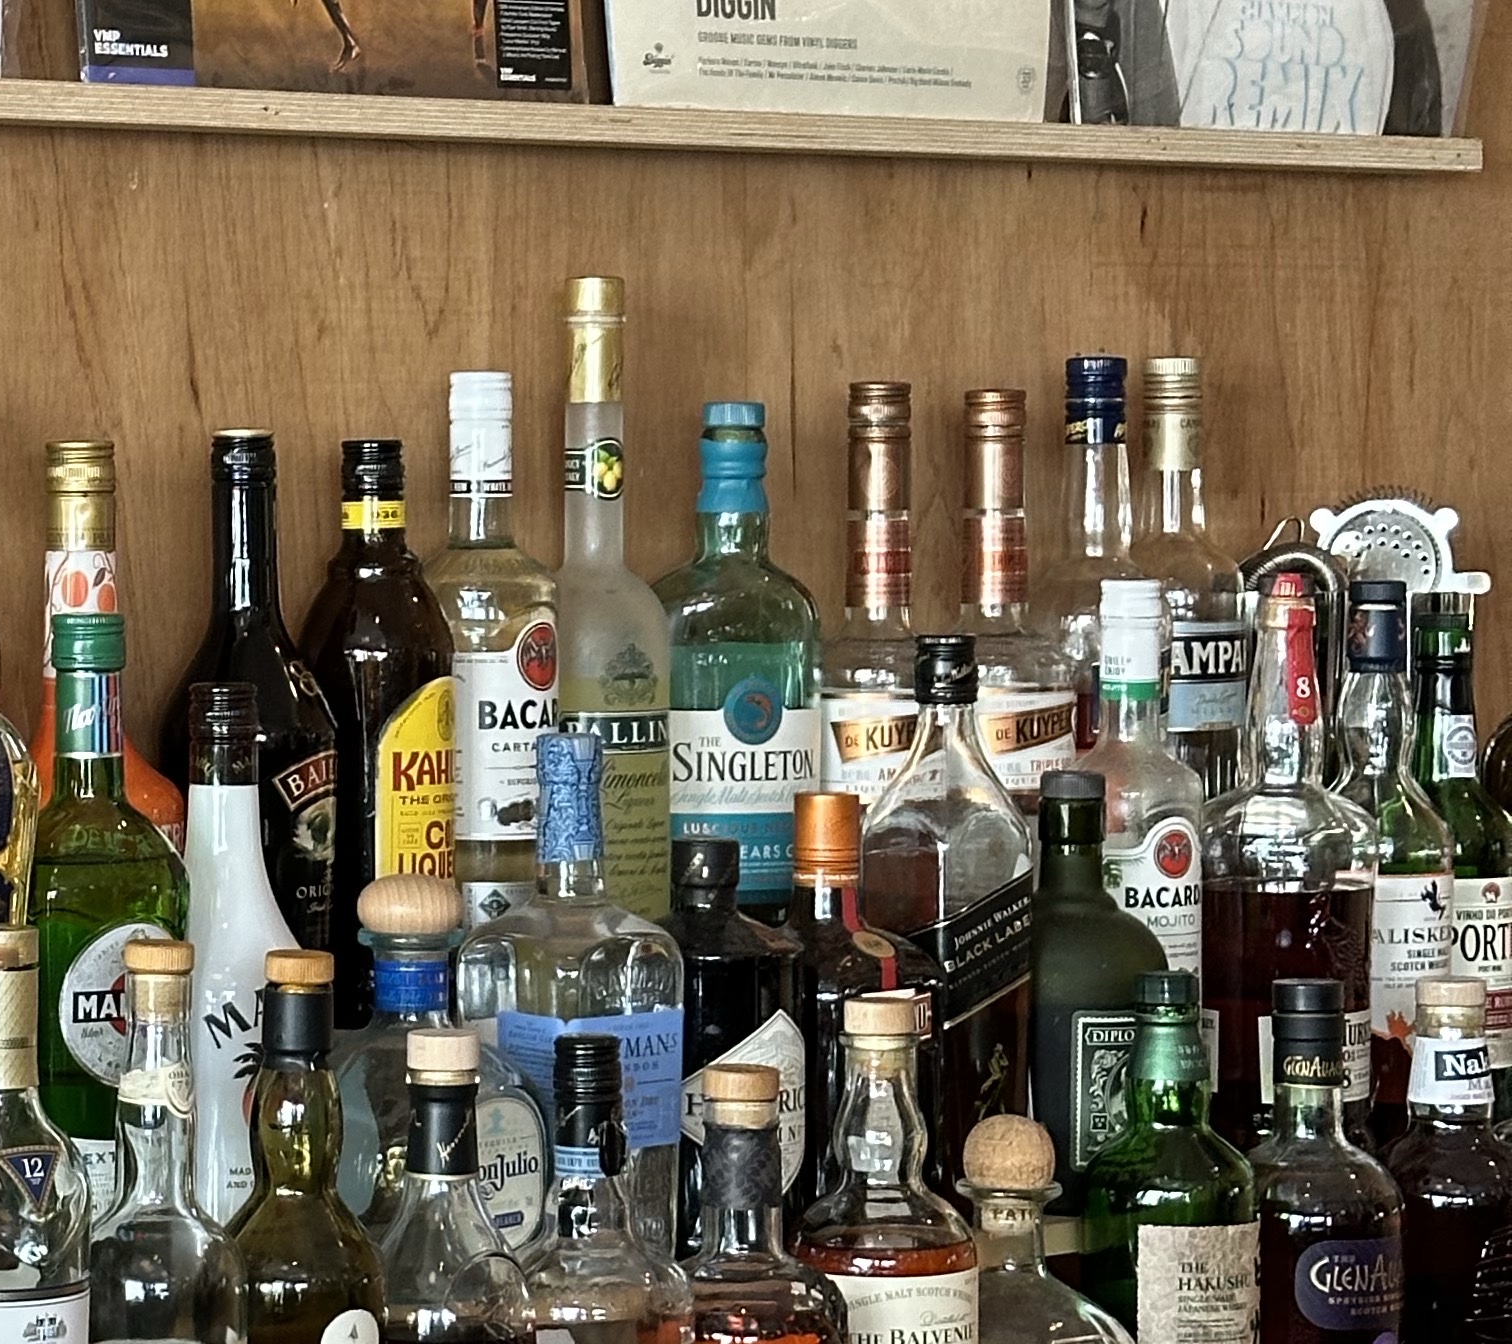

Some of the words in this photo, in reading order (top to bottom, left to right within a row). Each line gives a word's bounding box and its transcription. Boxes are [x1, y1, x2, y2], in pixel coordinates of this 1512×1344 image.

[93, 28, 120, 43] VMP
[1226, 18, 1345, 67] SOUND
[94, 40, 168, 58] ESSENTIALS
[1210, 58, 1364, 133] REMIX
[1296, 678, 1311, 699] 8
[699, 736, 721, 747] THE
[996, 728, 1011, 739] DE
[672, 742, 814, 782] SINGLETON
[399, 795, 430, 806] THE
[1147, 914, 1196, 928] MOJITO
[953, 920, 992, 951] JOHNNIE
[944, 939, 992, 974] BLACK
[22, 1158, 44, 1177] 12
[1180, 1262, 1209, 1274] THE
